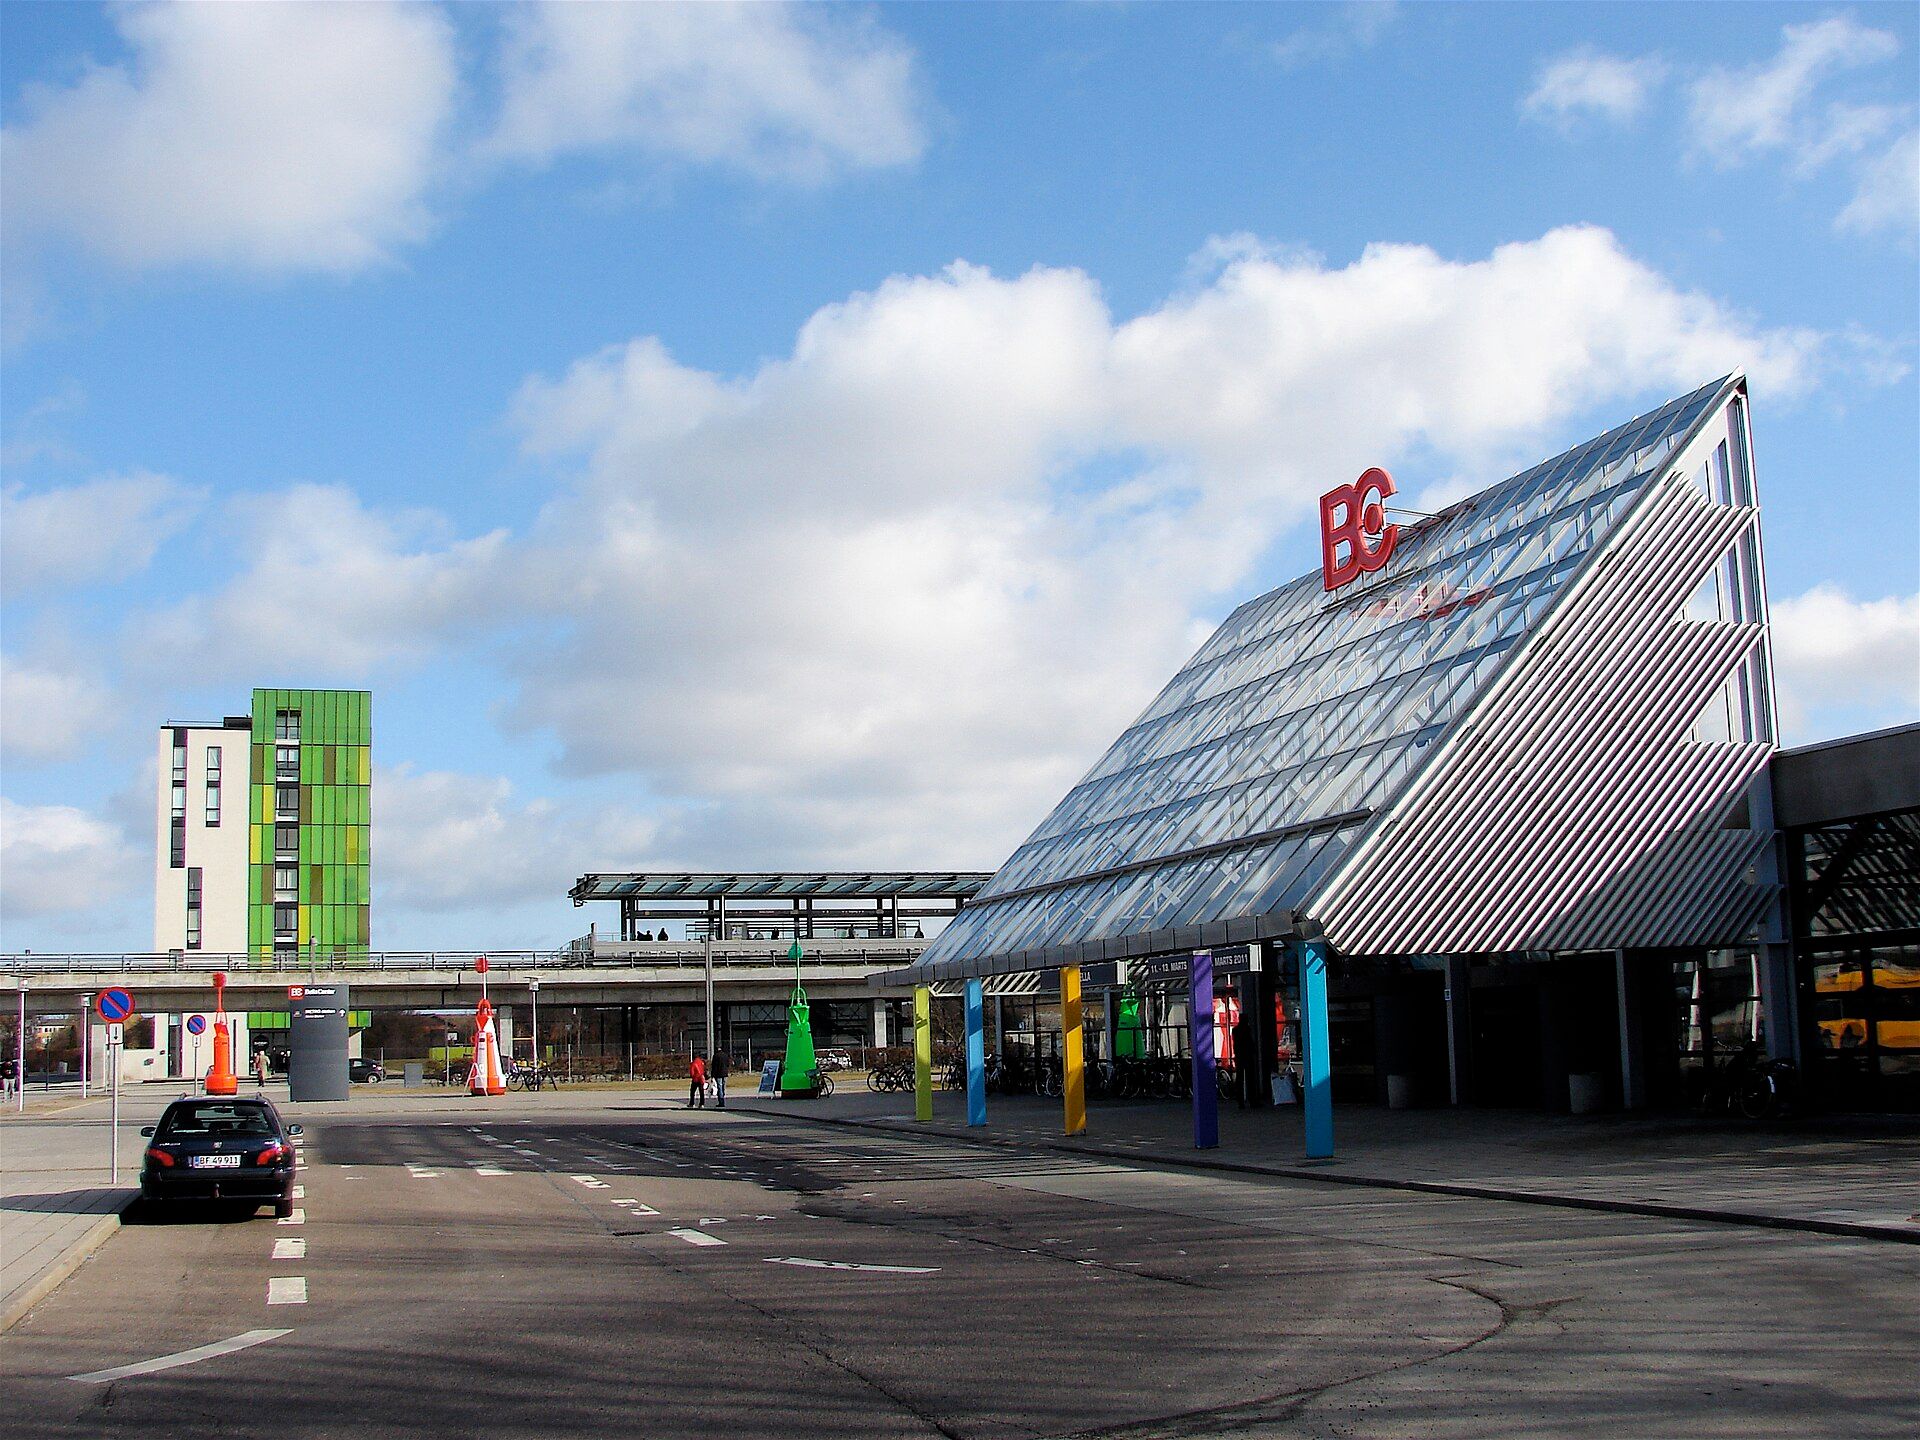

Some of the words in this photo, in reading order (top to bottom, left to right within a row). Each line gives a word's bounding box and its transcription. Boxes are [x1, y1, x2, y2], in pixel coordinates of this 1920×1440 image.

[1319, 467, 1399, 592] BC
[1170, 961, 1187, 972] MARTS
[1214, 956, 1233, 967] MARTS
[1234, 954, 1248, 964] 2011
[200, 1156, 210, 1165] BF
[212, 1156, 223, 1164] 49
[224, 1156, 238, 1164] 911
